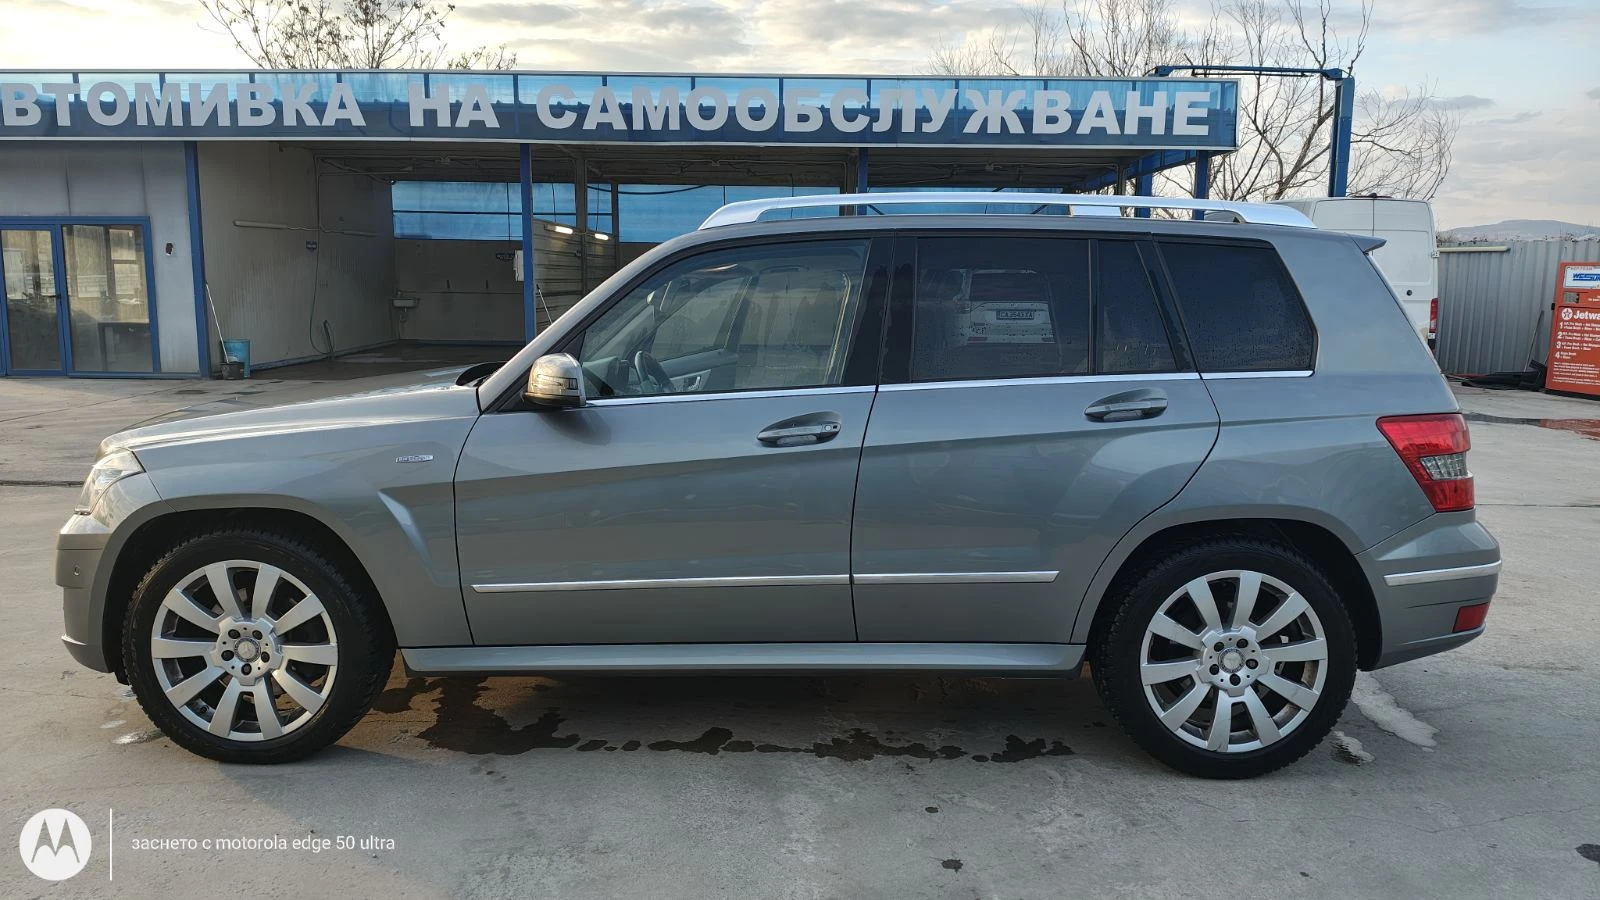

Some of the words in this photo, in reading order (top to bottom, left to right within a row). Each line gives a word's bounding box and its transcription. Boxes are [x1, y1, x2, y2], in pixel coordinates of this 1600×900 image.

[408, 83, 500, 128] НА
[535, 84, 1211, 136] САМООБСЛУЖВАНЕ
[1557, 331, 1563, 339] 2
[1556, 341, 1562, 349] 3
